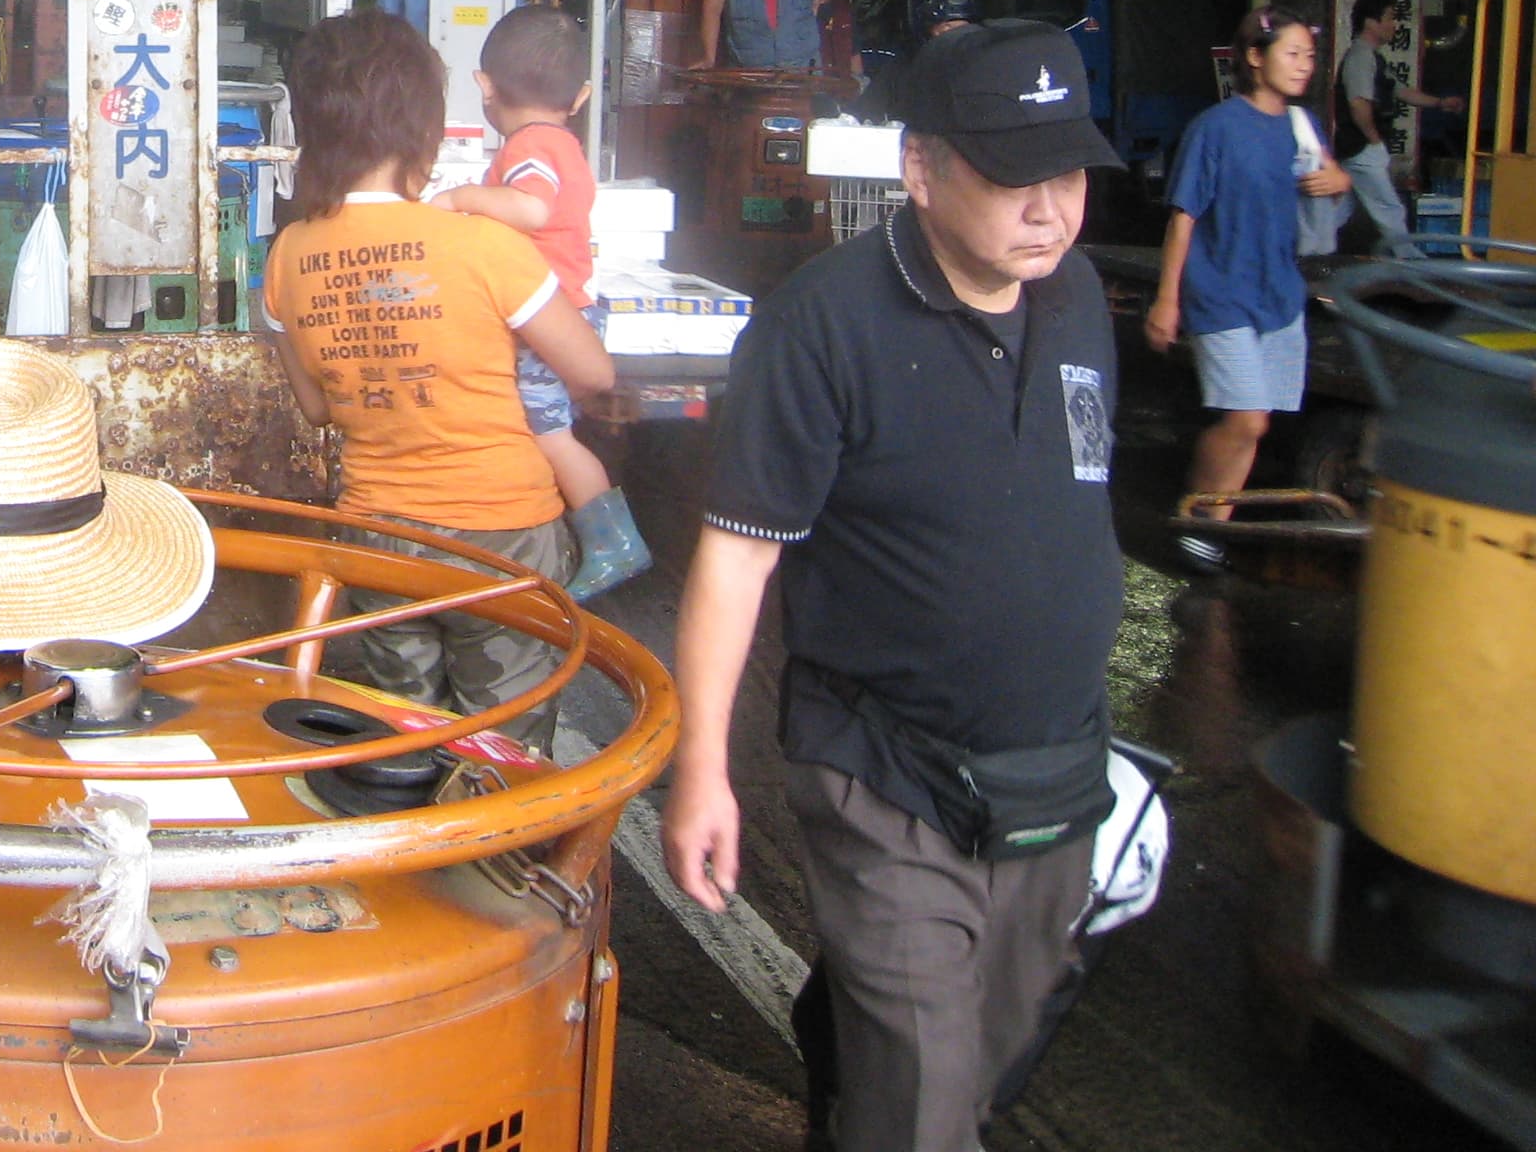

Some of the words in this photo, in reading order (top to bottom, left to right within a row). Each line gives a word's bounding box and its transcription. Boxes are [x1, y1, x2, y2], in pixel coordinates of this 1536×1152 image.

[114, 32, 171, 180] 大内
[299, 251, 332, 276] LIKE
[339, 241, 426, 269] FLOWERS
[324, 272, 363, 290] LOVE
[367, 268, 393, 284] THE
[311, 293, 340, 310] SUN
[296, 310, 341, 329] MORE!
[347, 309, 372, 324] THE
[376, 304, 443, 322] OCEANS
[331, 325, 369, 343] LOVE
[374, 325, 399, 340] THE
[320, 345, 370, 361] SHORE
[373, 342, 420, 359] PARTY
